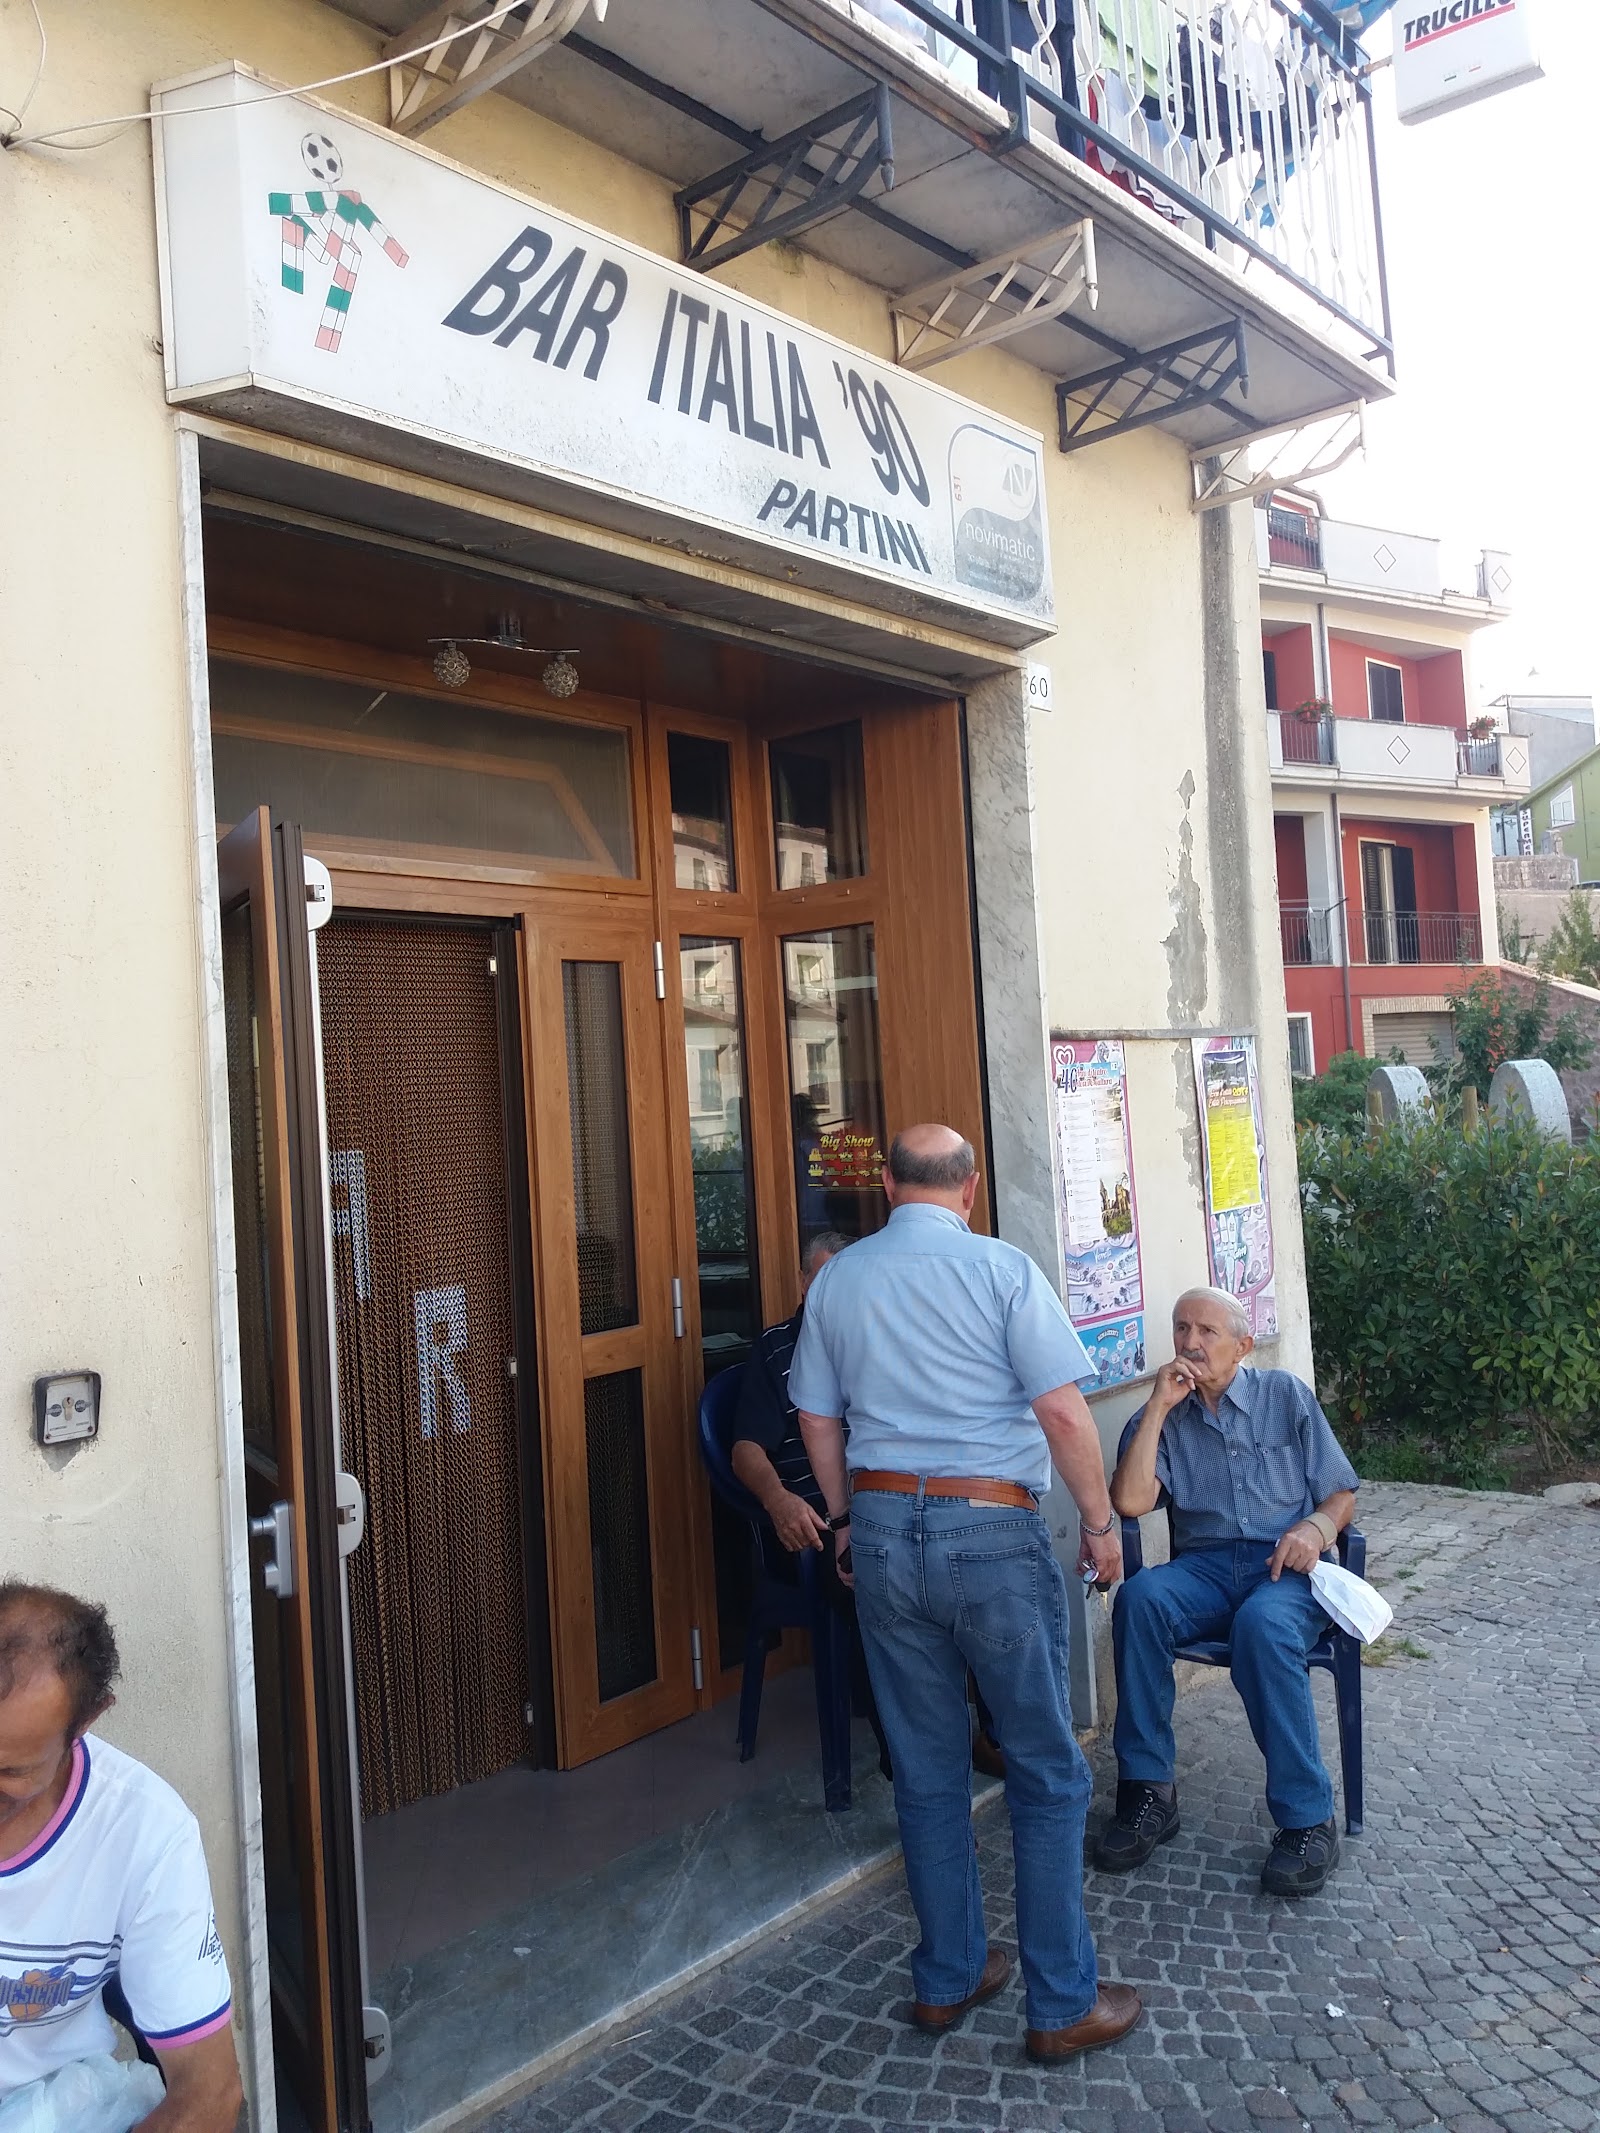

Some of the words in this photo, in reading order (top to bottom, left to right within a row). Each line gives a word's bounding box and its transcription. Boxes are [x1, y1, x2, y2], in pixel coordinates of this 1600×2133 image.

[1404, 0, 1511, 43] TRUCILL
[442, 225, 628, 381] BAR
[647, 288, 831, 470] ITALIA
[832, 360, 931, 508] '90
[756, 478, 932, 576] PARTINI
[965, 521, 1035, 561] novimatic
[820, 1134, 841, 1151] Big
[843, 1134, 877, 1148] Show
